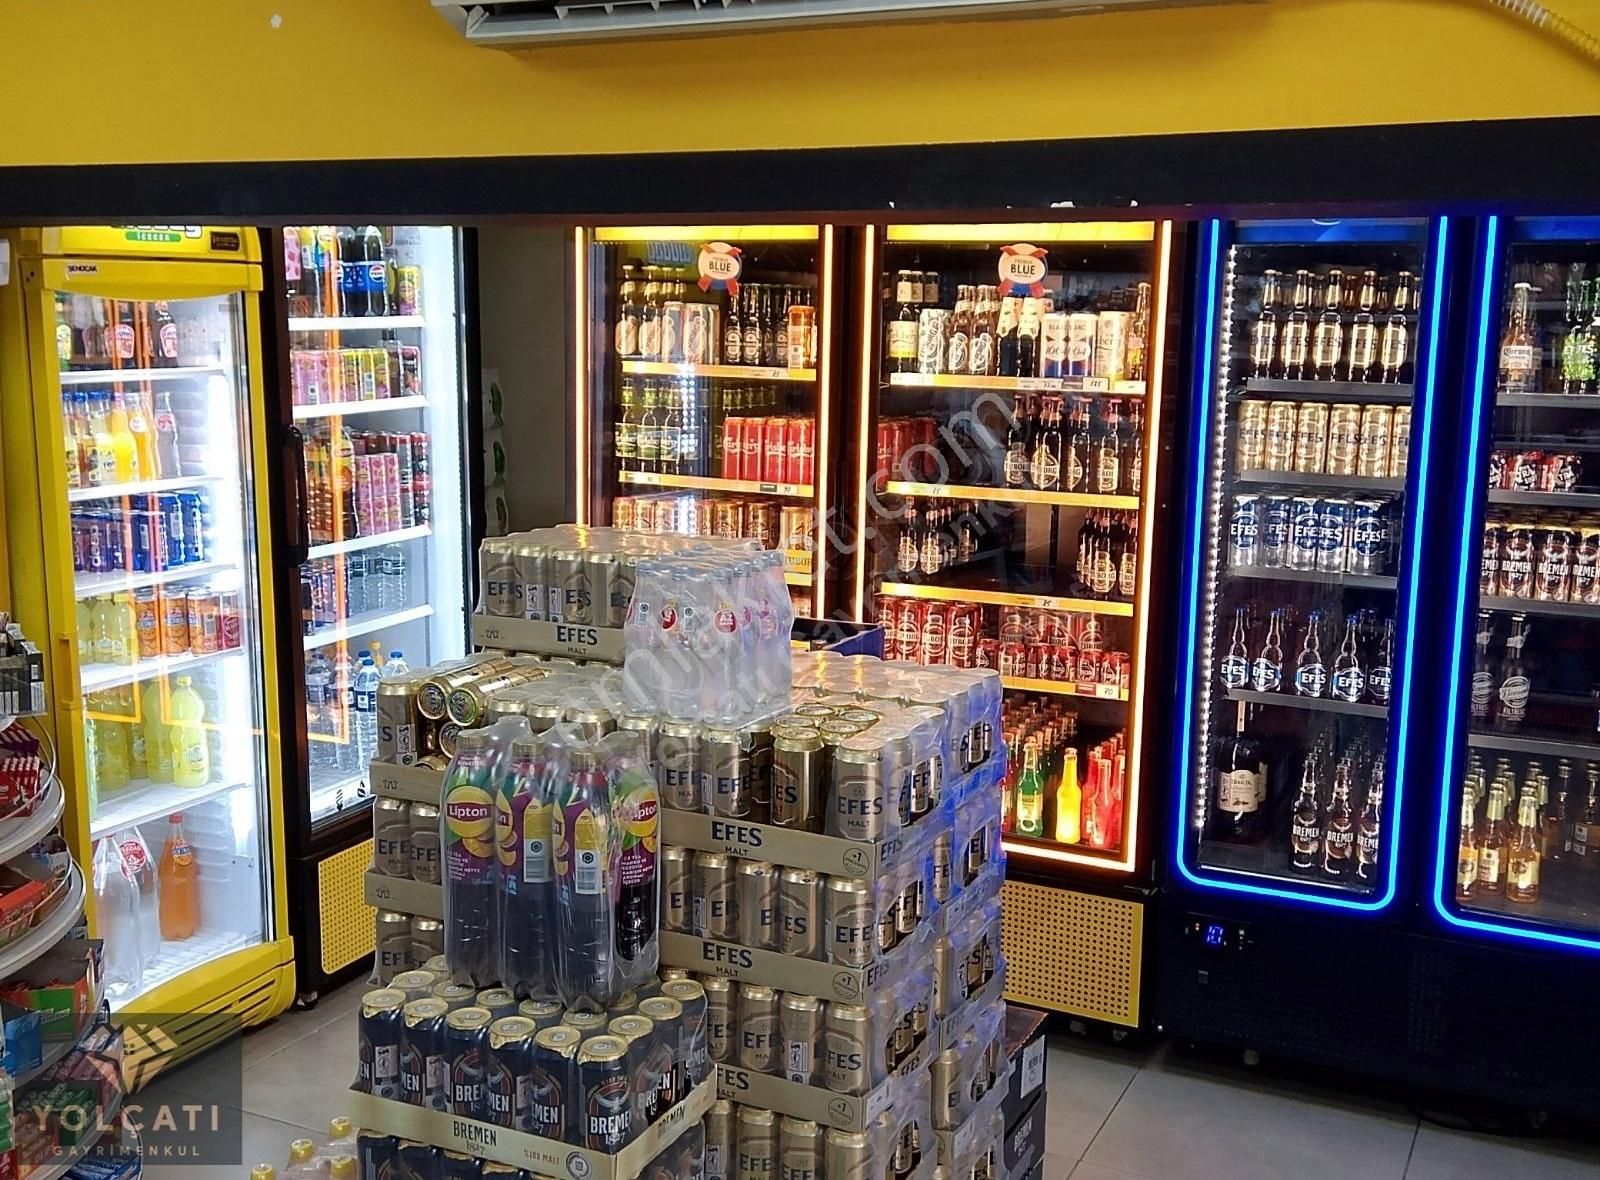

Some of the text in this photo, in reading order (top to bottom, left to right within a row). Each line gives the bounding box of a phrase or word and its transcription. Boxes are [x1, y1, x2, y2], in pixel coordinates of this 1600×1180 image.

[709, 261, 731, 272] BLUE
[1010, 263, 1036, 276] BLUE
[1230, 524, 1258, 536] EFES
[1294, 525, 1318, 538] EFE
[1502, 560, 1532, 573] BREMEN
[1538, 562, 1570, 576] BREMEN
[556, 625, 598, 646] EFES
[567, 647, 587, 655] MALT
[1301, 674, 1326, 684] EFES
[1338, 676, 1364, 688] EFES
[776, 785, 798, 803] ES
[449, 805, 488, 819] Lipton
[837, 796, 883, 816] EFES
[711, 820, 762, 847] EFES
[1292, 826, 1320, 838] BREMEN
[1356, 834, 1379, 848] BREME
[725, 846, 749, 856] MALT
[784, 916, 807, 935] ES
[702, 941, 753, 969] EFES
[715, 966, 739, 977] MALT
[827, 1050, 862, 1071] FES
[716, 1067, 750, 1091] FES
[453, 1120, 498, 1146] BREMEN
[739, 1154, 773, 1172] EFE
